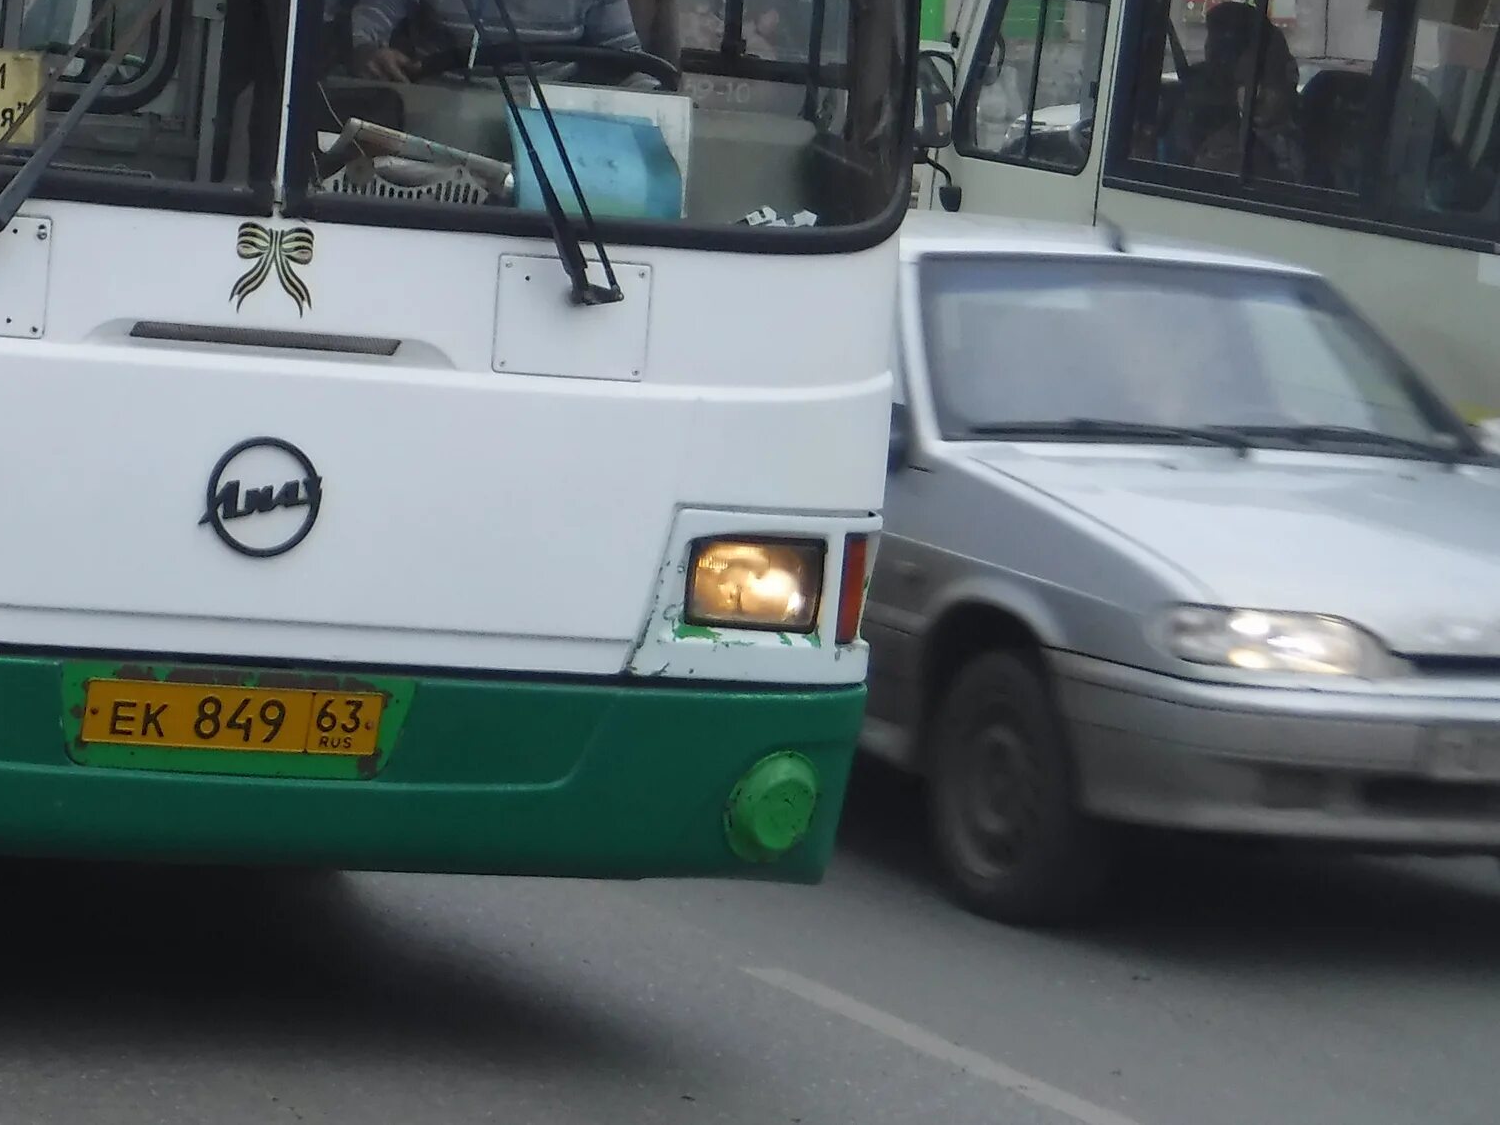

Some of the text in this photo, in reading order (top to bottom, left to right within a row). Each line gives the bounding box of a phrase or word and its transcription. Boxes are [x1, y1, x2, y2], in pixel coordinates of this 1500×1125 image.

[194, 695, 286, 743] 849
[316, 698, 364, 734] 63
[318, 736, 352, 749] RUS
